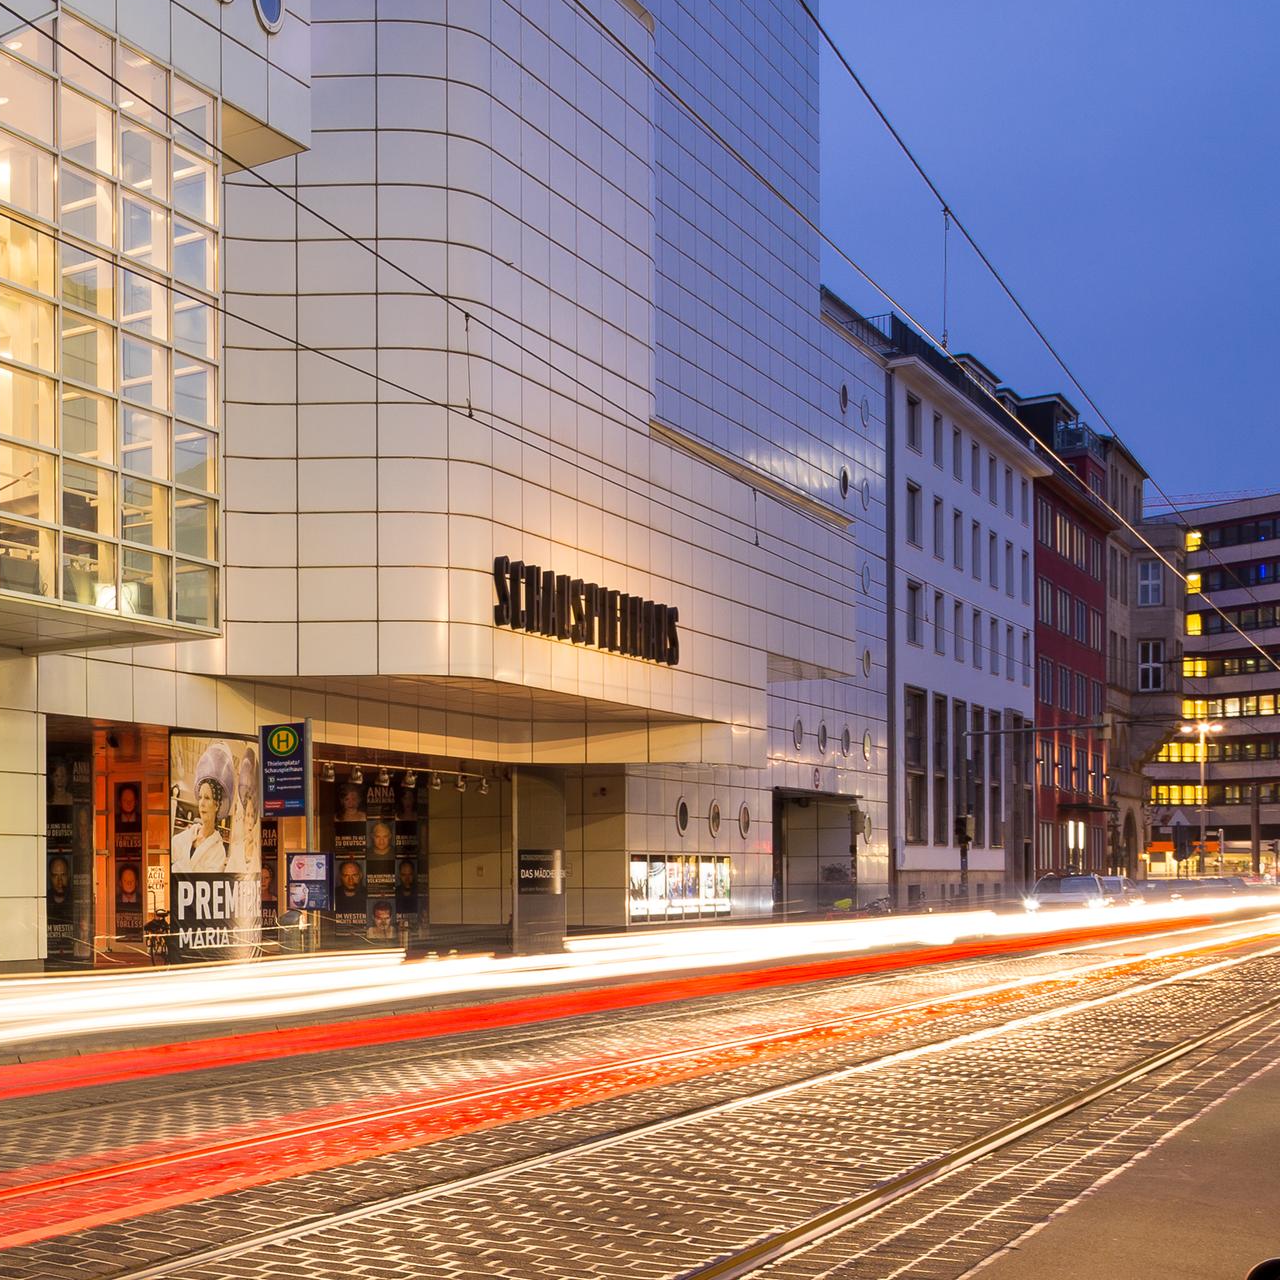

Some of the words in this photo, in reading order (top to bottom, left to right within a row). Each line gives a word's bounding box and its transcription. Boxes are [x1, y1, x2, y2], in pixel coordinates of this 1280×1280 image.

[494, 555, 679, 666] SCHAUSPIELHAUS
[277, 733, 289, 749] H
[264, 766, 303, 774] Schauspielhaus
[367, 787, 395, 797] ANNA
[262, 838, 277, 847] ART
[520, 869, 533, 878] DAS
[178, 927, 230, 949] MARIA
